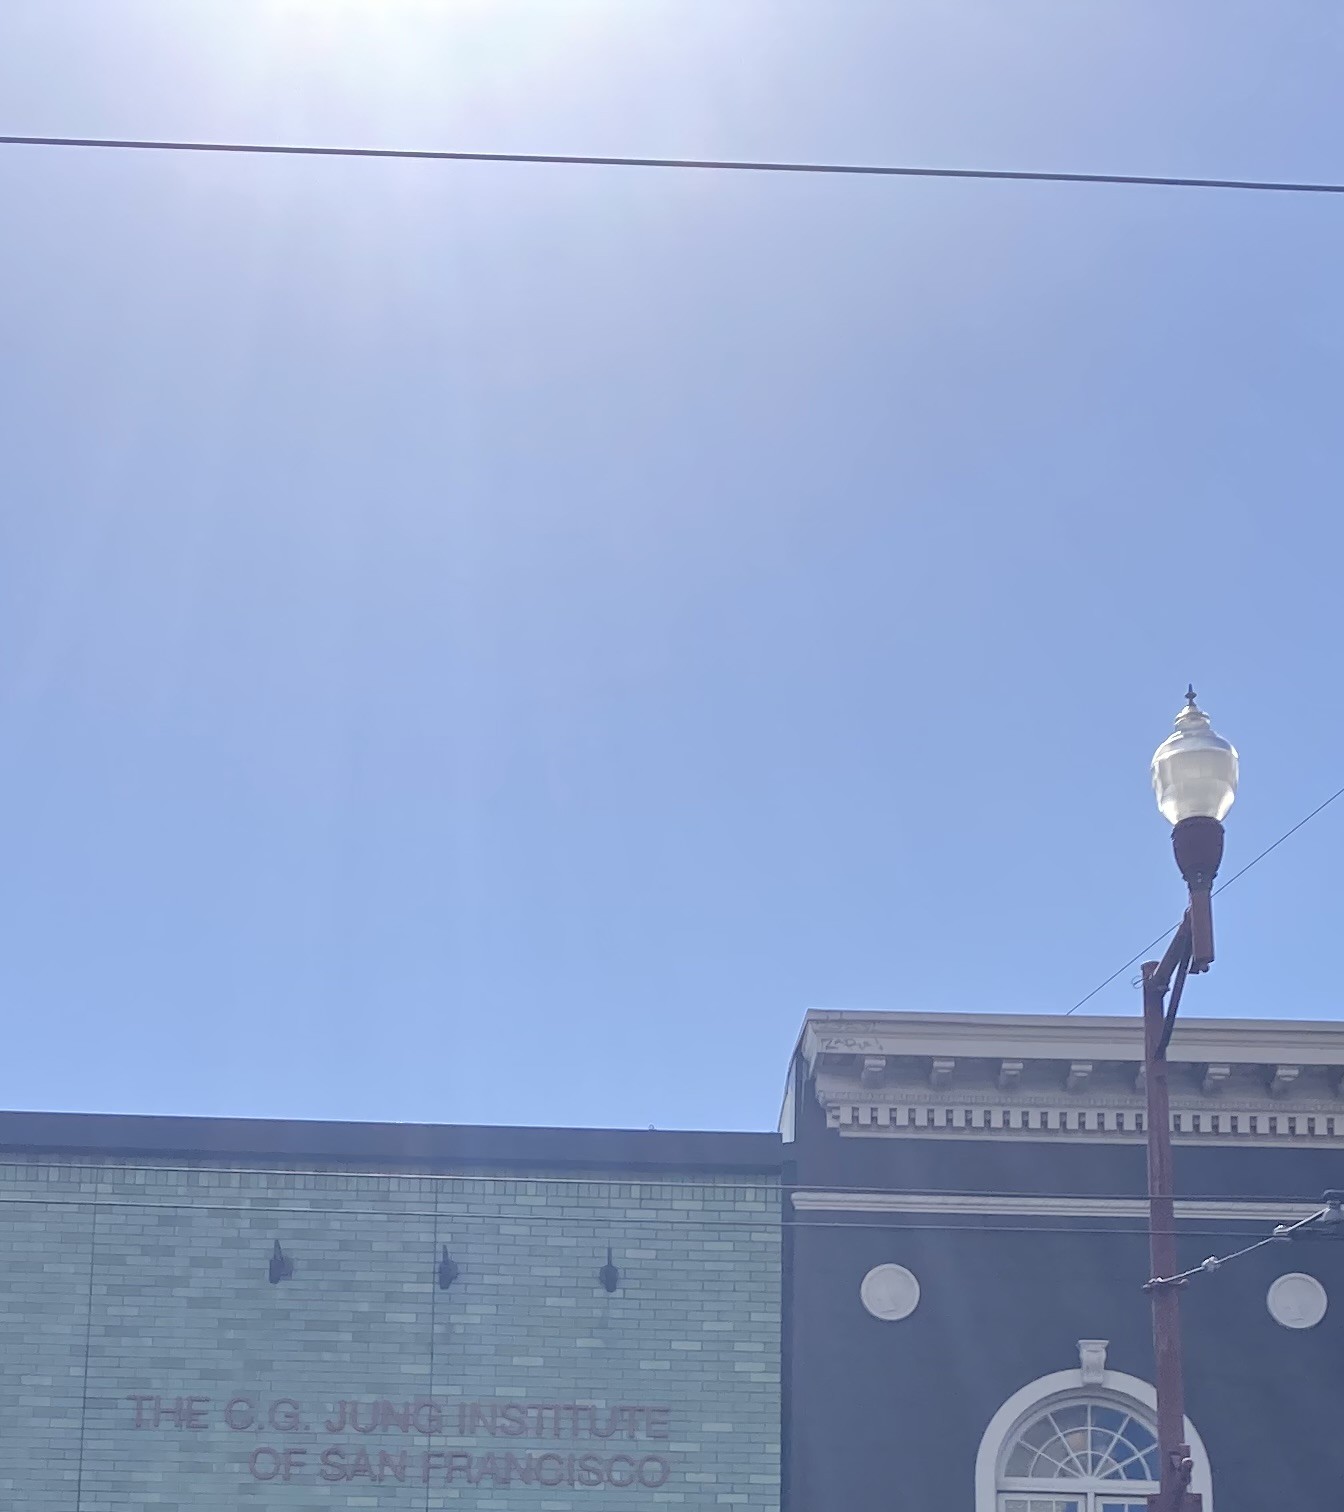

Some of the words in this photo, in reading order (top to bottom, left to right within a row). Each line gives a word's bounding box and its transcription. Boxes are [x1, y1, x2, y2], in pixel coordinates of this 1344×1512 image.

[128, 1395, 210, 1429] THE
[224, 1398, 309, 1432] C.G.
[325, 1398, 443, 1434] JUNG
[458, 1402, 671, 1439] INSTITUTE
[249, 1446, 307, 1482] OF
[319, 1446, 407, 1482] SAN
[421, 1451, 671, 1488] FRANCISCO
